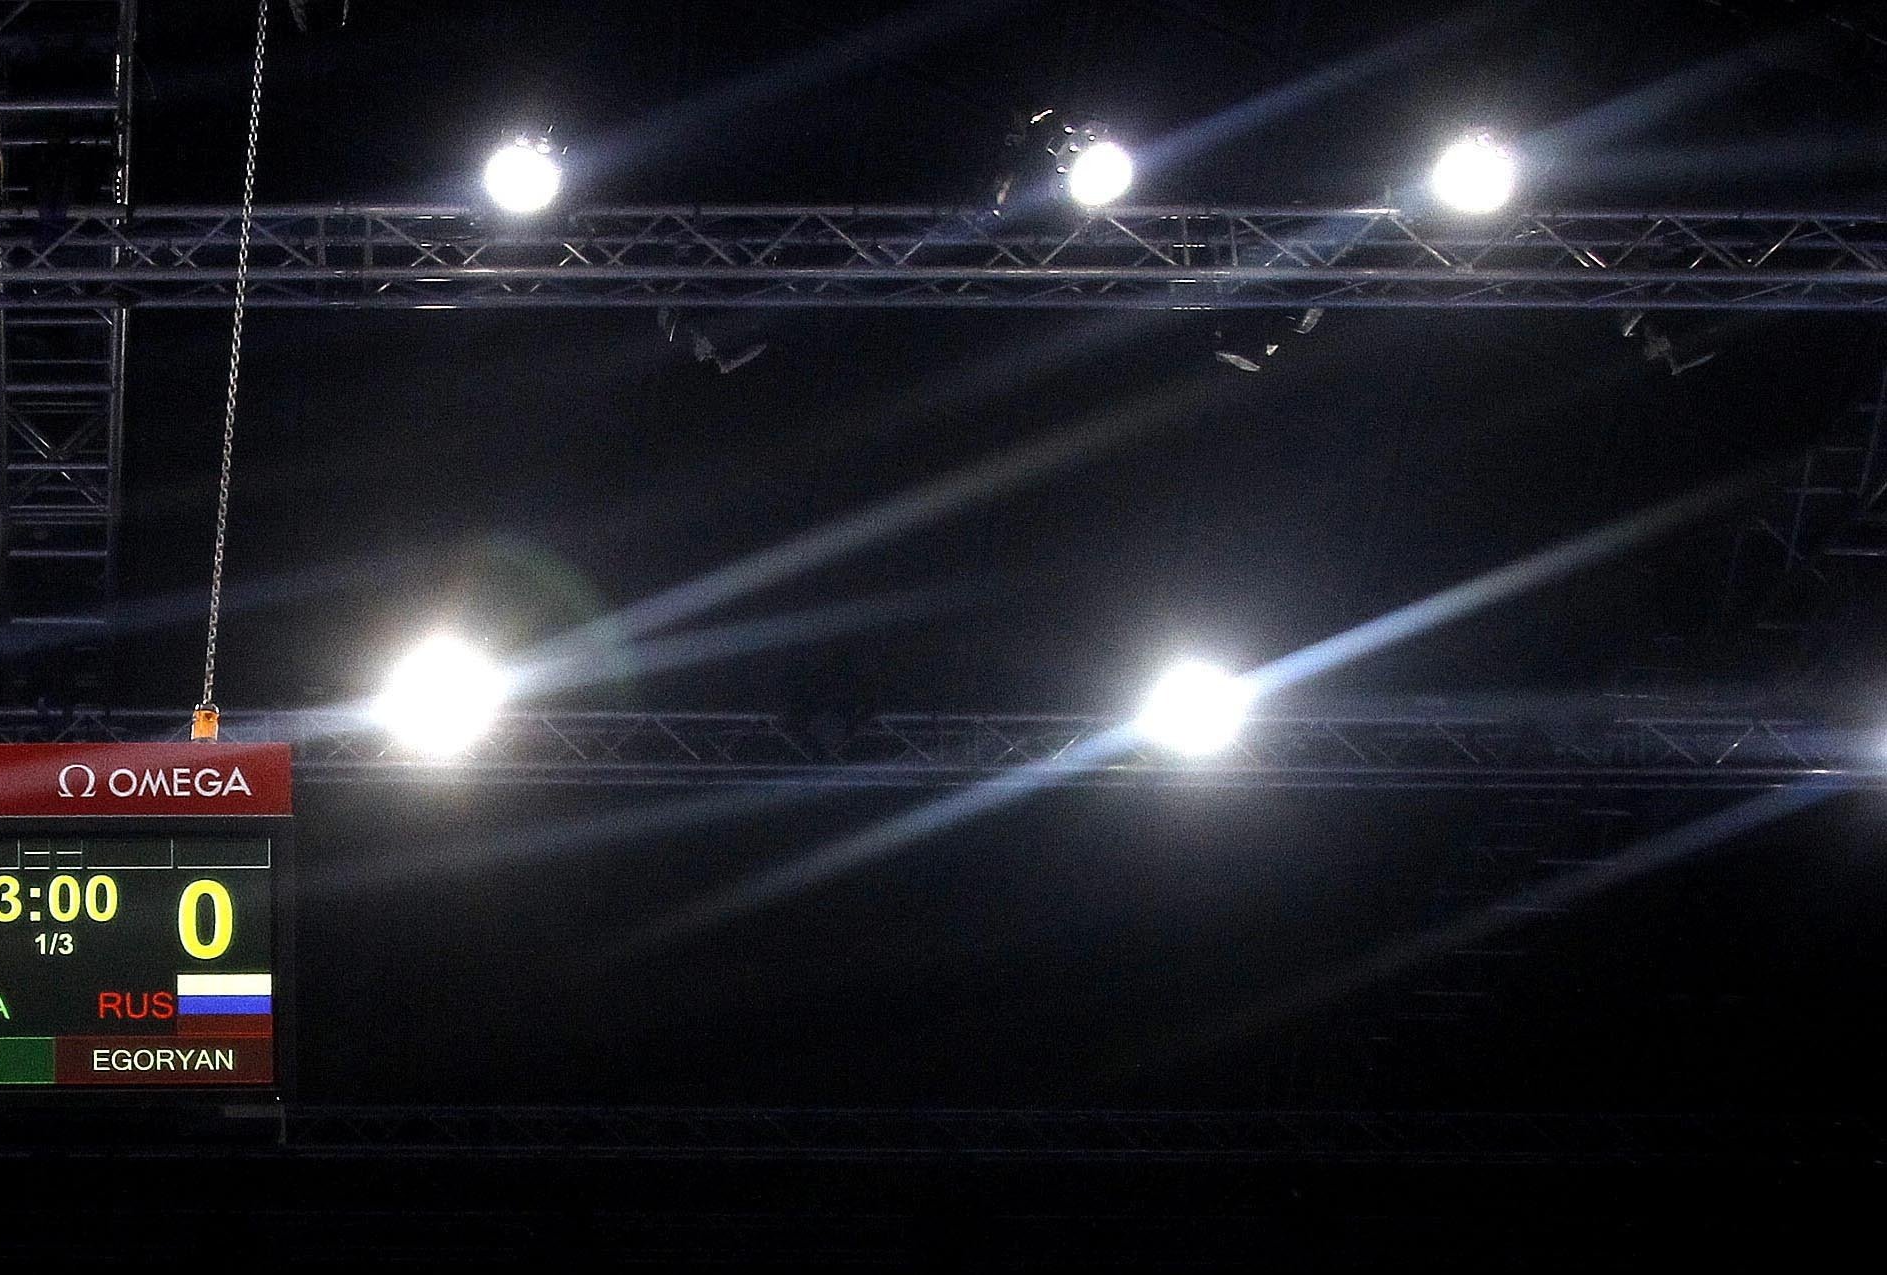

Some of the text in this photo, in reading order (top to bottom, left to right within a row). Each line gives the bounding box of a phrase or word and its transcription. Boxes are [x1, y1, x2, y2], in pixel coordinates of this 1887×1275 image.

[109, 767, 251, 796] OMEGA
[178, 880, 234, 959] 0
[34, 933, 74, 954] 1/3
[99, 992, 174, 1018] RUS
[94, 1049, 234, 1070] EGORYAN
